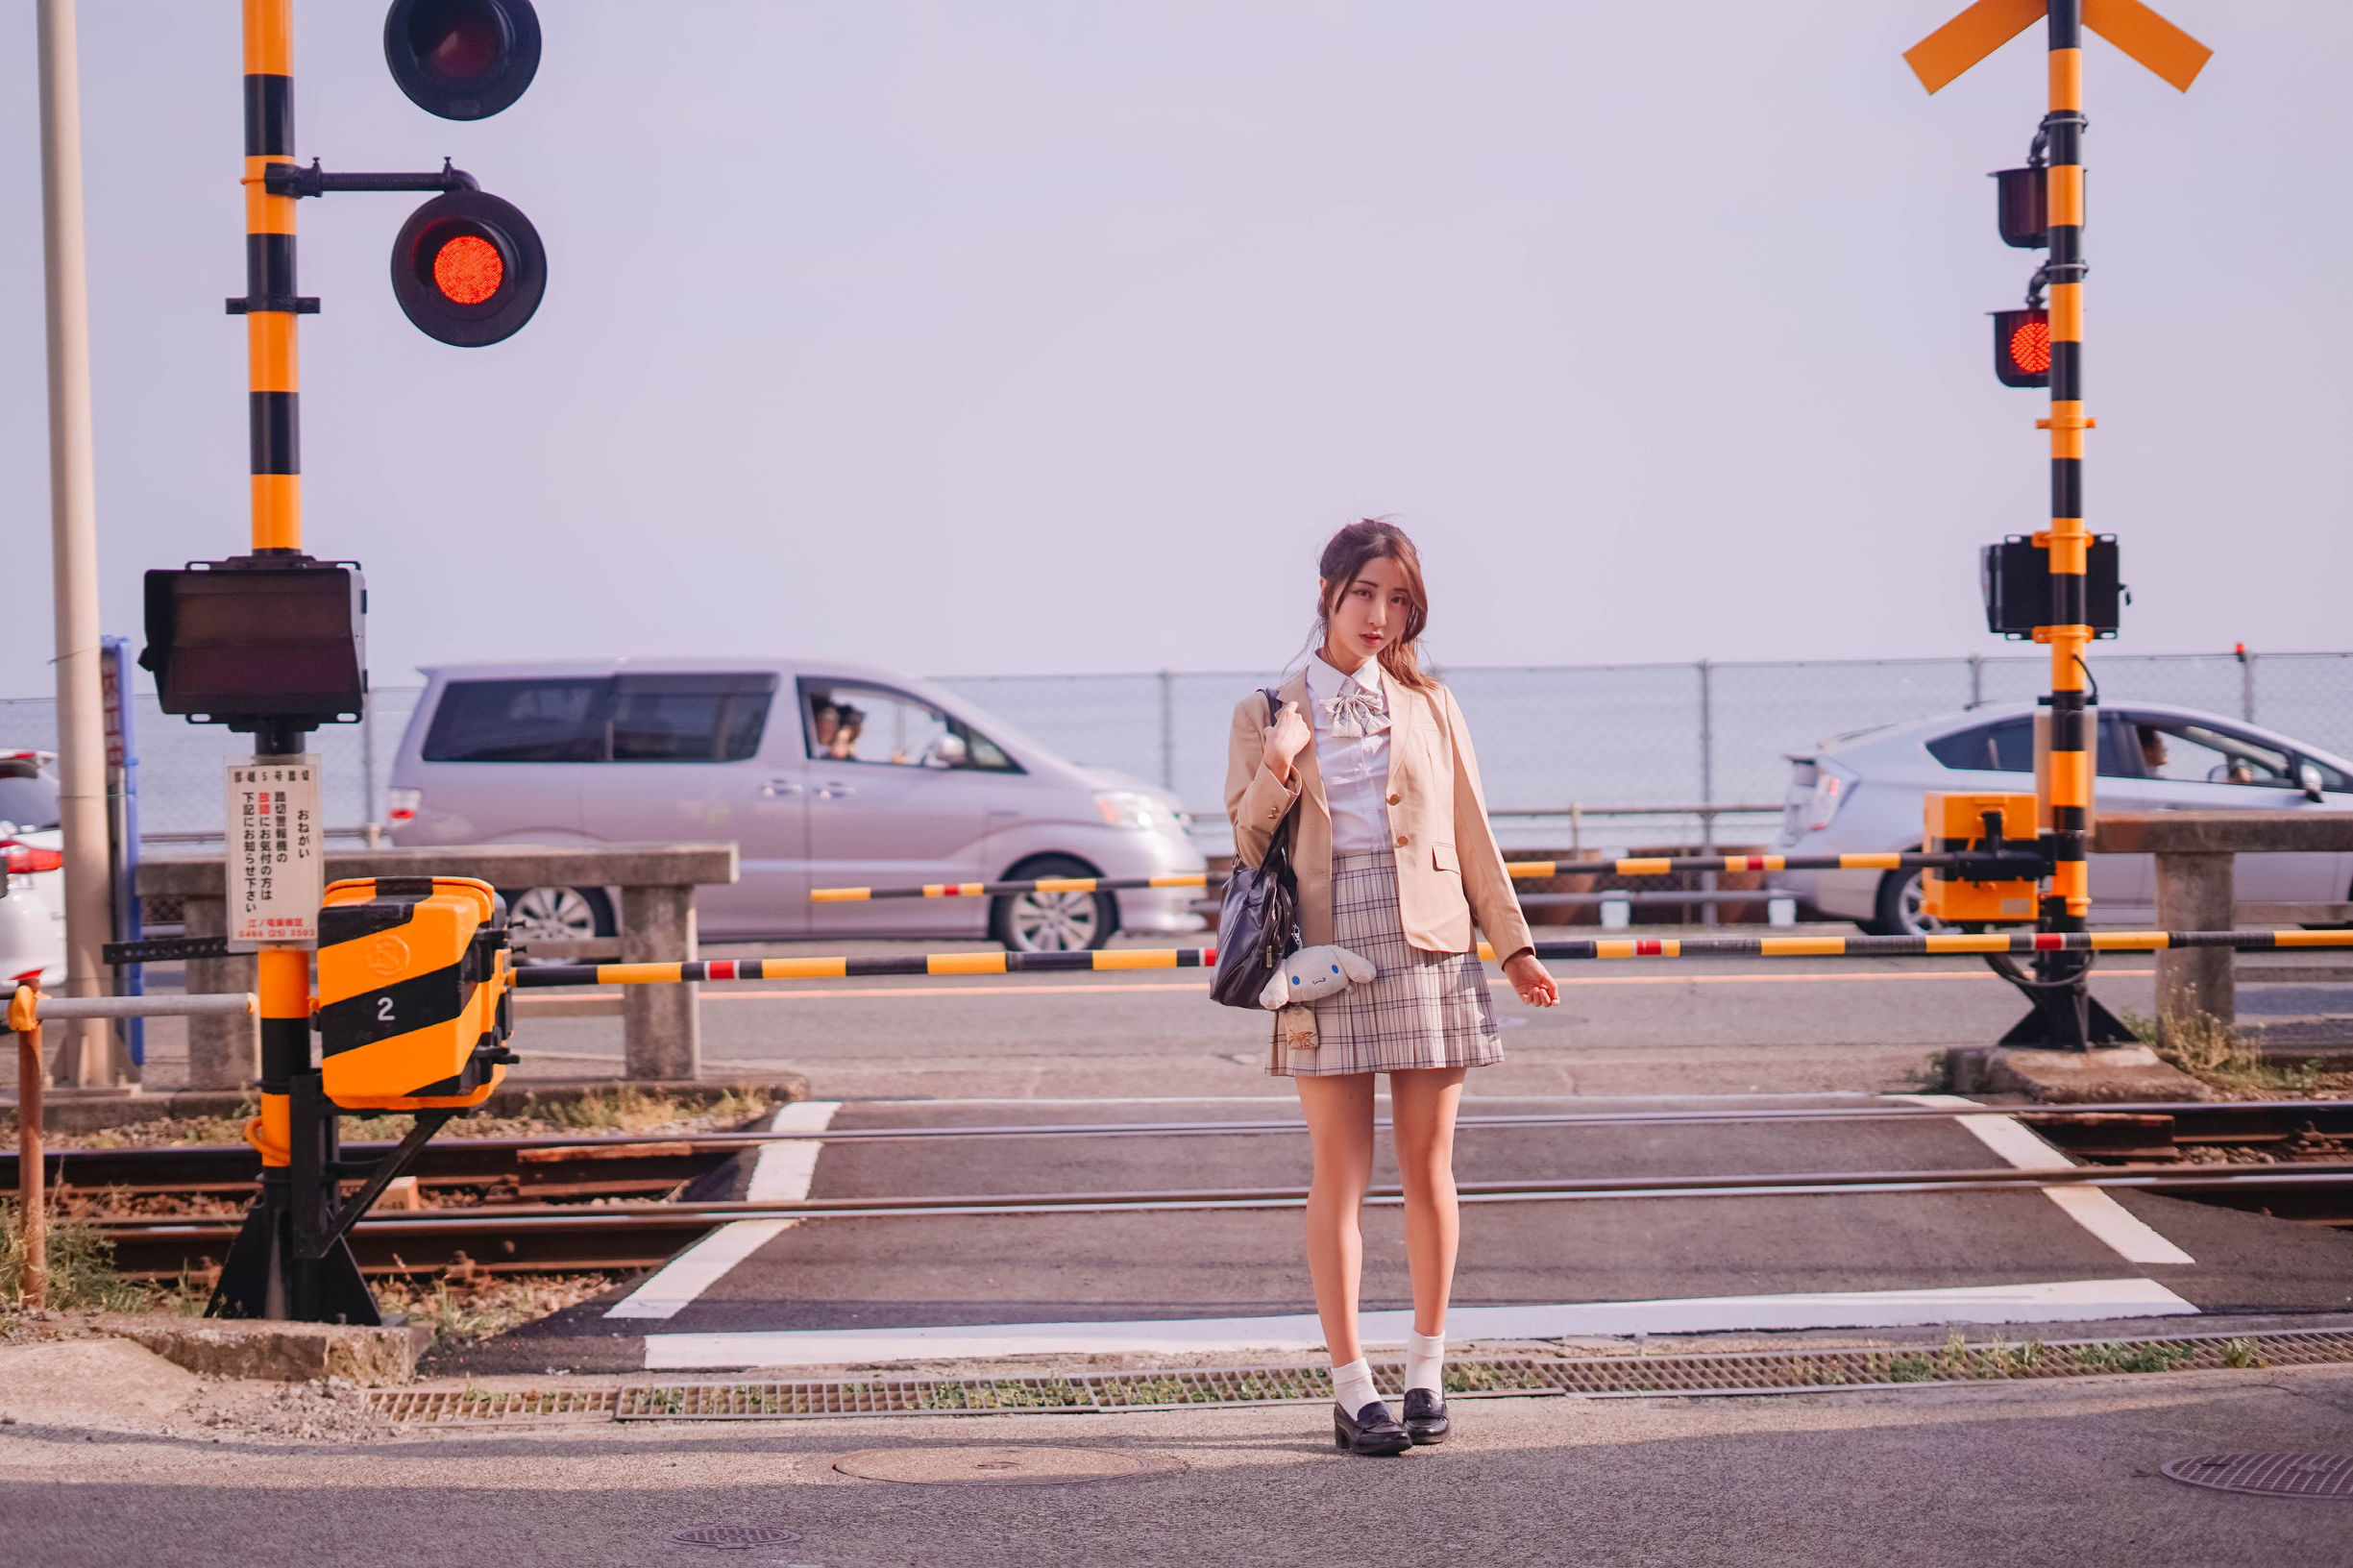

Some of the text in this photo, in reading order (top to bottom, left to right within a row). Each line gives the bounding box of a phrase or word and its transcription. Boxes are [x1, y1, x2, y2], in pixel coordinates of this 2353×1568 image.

[242, 792, 257, 913] 下記にお知らせ下さい
[258, 792, 273, 901] 故障にお気付の方は
[275, 791, 288, 863] 踏切警報機の
[297, 809, 310, 859] おねがい
[377, 996, 396, 1021] 2
